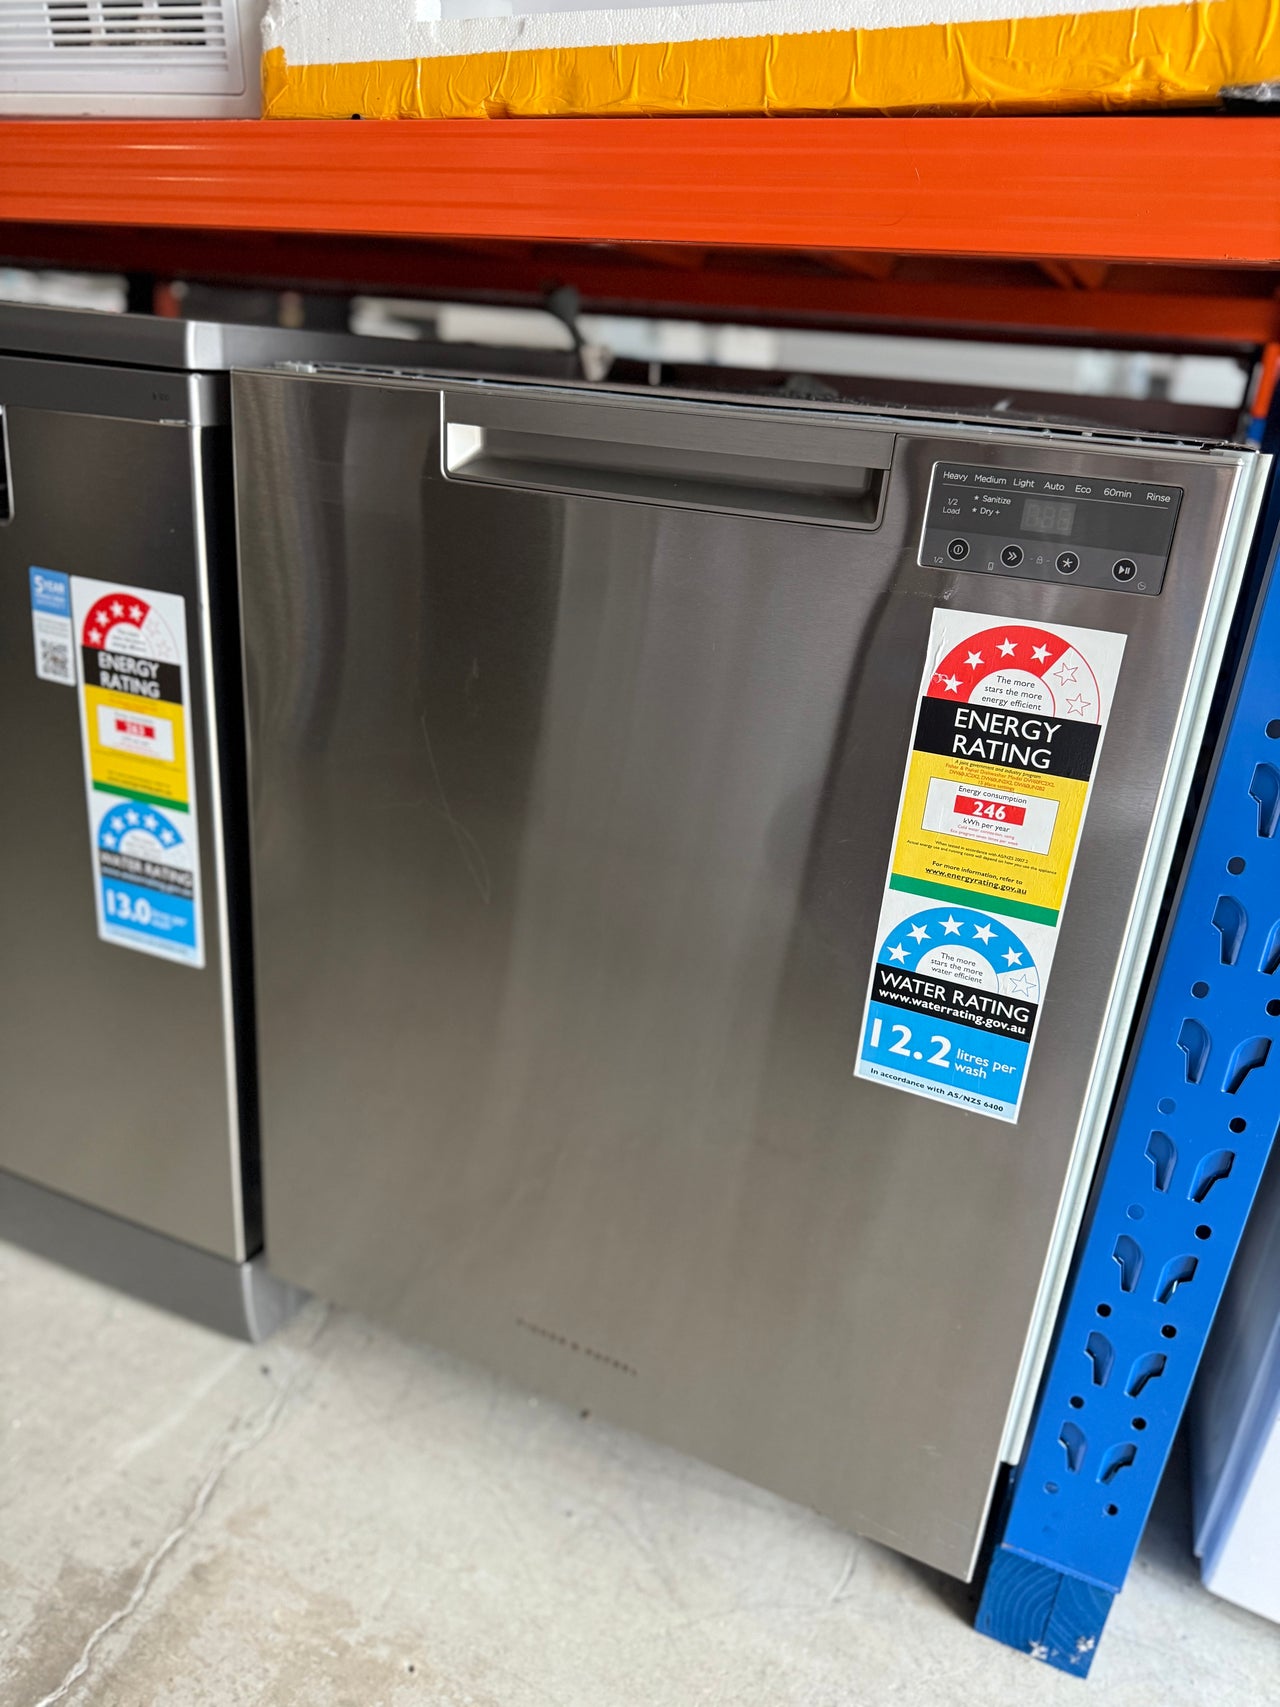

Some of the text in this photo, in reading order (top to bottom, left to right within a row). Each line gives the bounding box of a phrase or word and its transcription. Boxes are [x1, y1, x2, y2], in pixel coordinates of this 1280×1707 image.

[943, 471, 1171, 503] Heavy Medium Light Auto Eco 60min Rinse
[948, 498, 958, 506] 1/2
[982, 495, 1011, 505] Sanitize
[943, 506, 960, 515] Load
[980, 507, 993, 517] Dry
[933, 556, 944, 564] 1/2
[98, 652, 160, 680] ENERGY
[100, 672, 160, 699] RATING
[997, 675, 1035, 688] The more
[984, 686, 1043, 700] stars the more
[981, 696, 1041, 711] energy efficient
[954, 708, 1062, 743] ENERGY
[952, 734, 1052, 769] RATING
[958, 785, 1028, 805] Energy consumption
[972, 801, 1006, 821] 246
[963, 818, 980, 827] kWh
[994, 825, 1010, 833] year
[925, 867, 1028, 896] www.energyrating.gov.au
[943, 864, 961, 872] more
[961, 867, 999, 881] information,
[999, 875, 1015, 884] refer
[106, 888, 152, 926] 13.0
[930, 959, 983, 977] stars the more
[940, 952, 976, 967] The more
[931, 967, 983, 984] water efficient
[880, 970, 1030, 1023] WATER RATING
[878, 989, 1026, 1035] www.waterrating.gov.au
[870, 1017, 1017, 1073] 12.2 litres per
[954, 1062, 987, 1079] wash
[880, 1072, 925, 1089] accordance
[926, 1085, 945, 1095] with
[946, 1091, 981, 1105] AS/NZS
[983, 1101, 1004, 1112] 6400
